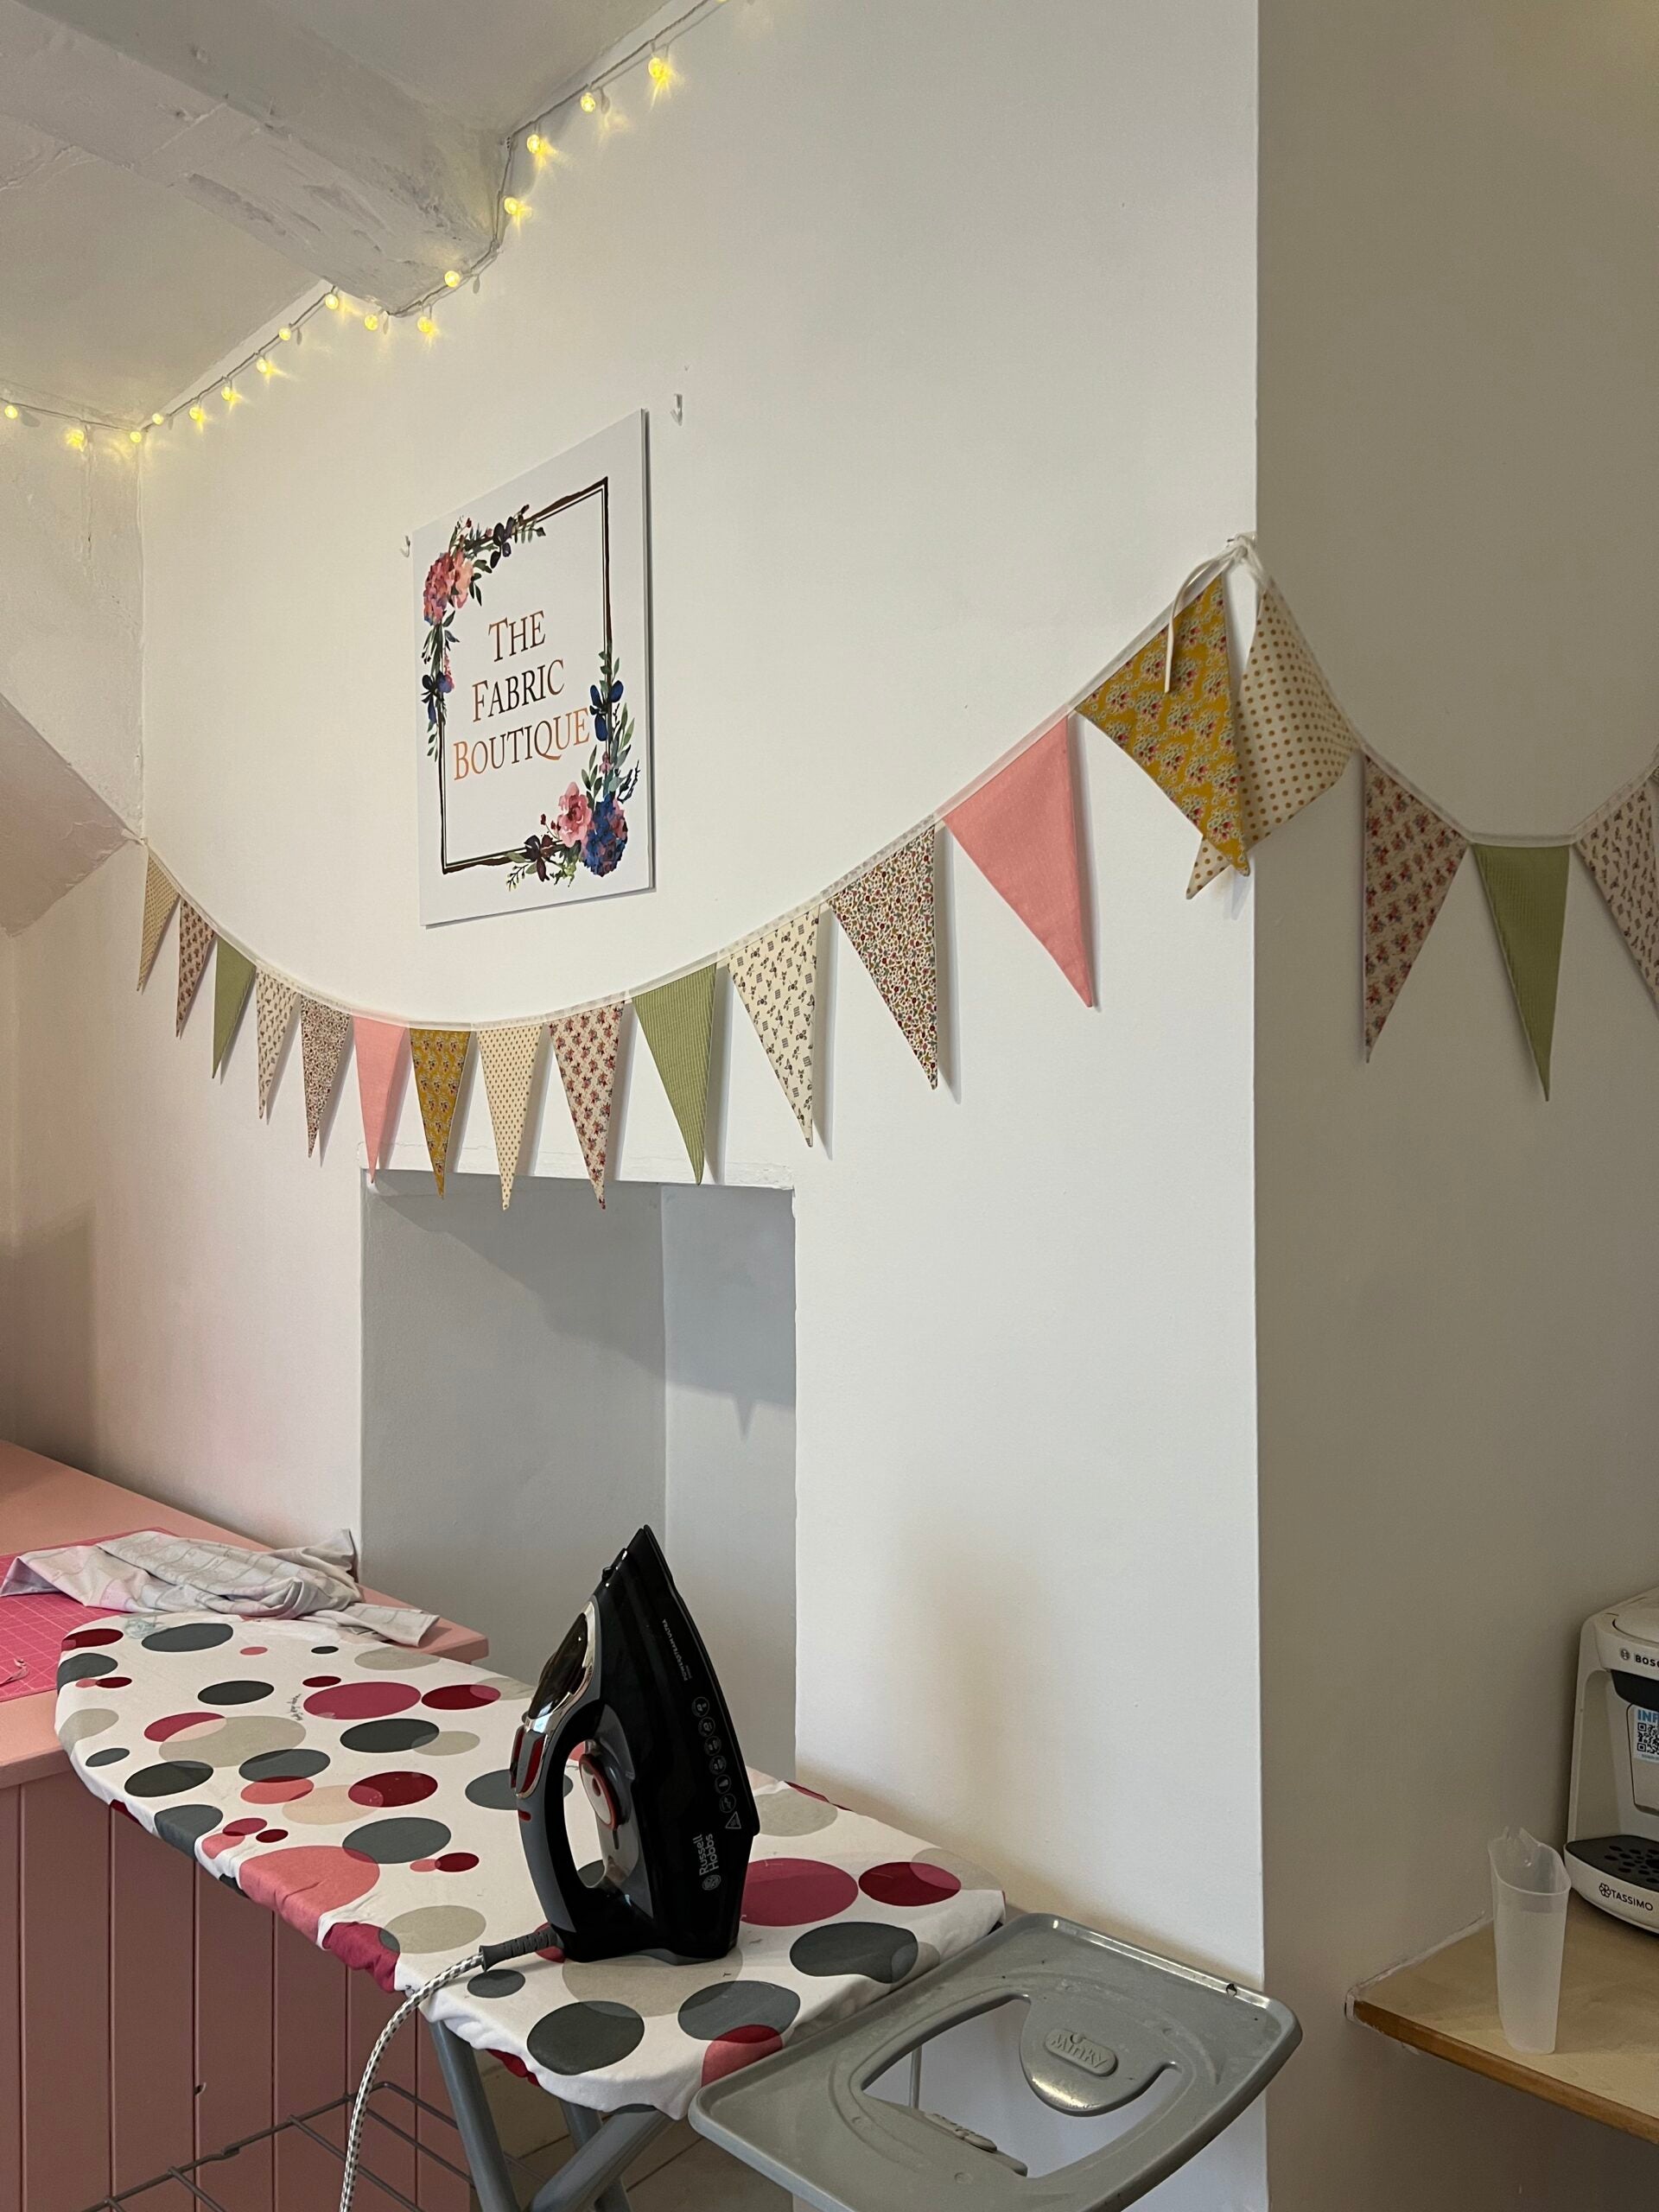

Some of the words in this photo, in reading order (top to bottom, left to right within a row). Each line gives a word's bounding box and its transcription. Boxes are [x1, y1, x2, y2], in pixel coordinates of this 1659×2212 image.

[488, 610, 546, 663] THE
[472, 659, 566, 723] FABRIC
[453, 706, 591, 781] BOUTIQUE
[1635, 1654, 1659, 1668] BOS
[692, 1834, 709, 1876] Russell
[705, 1834, 720, 1872] Hobbs
[1611, 1889, 1654, 1911] TASSIMO
